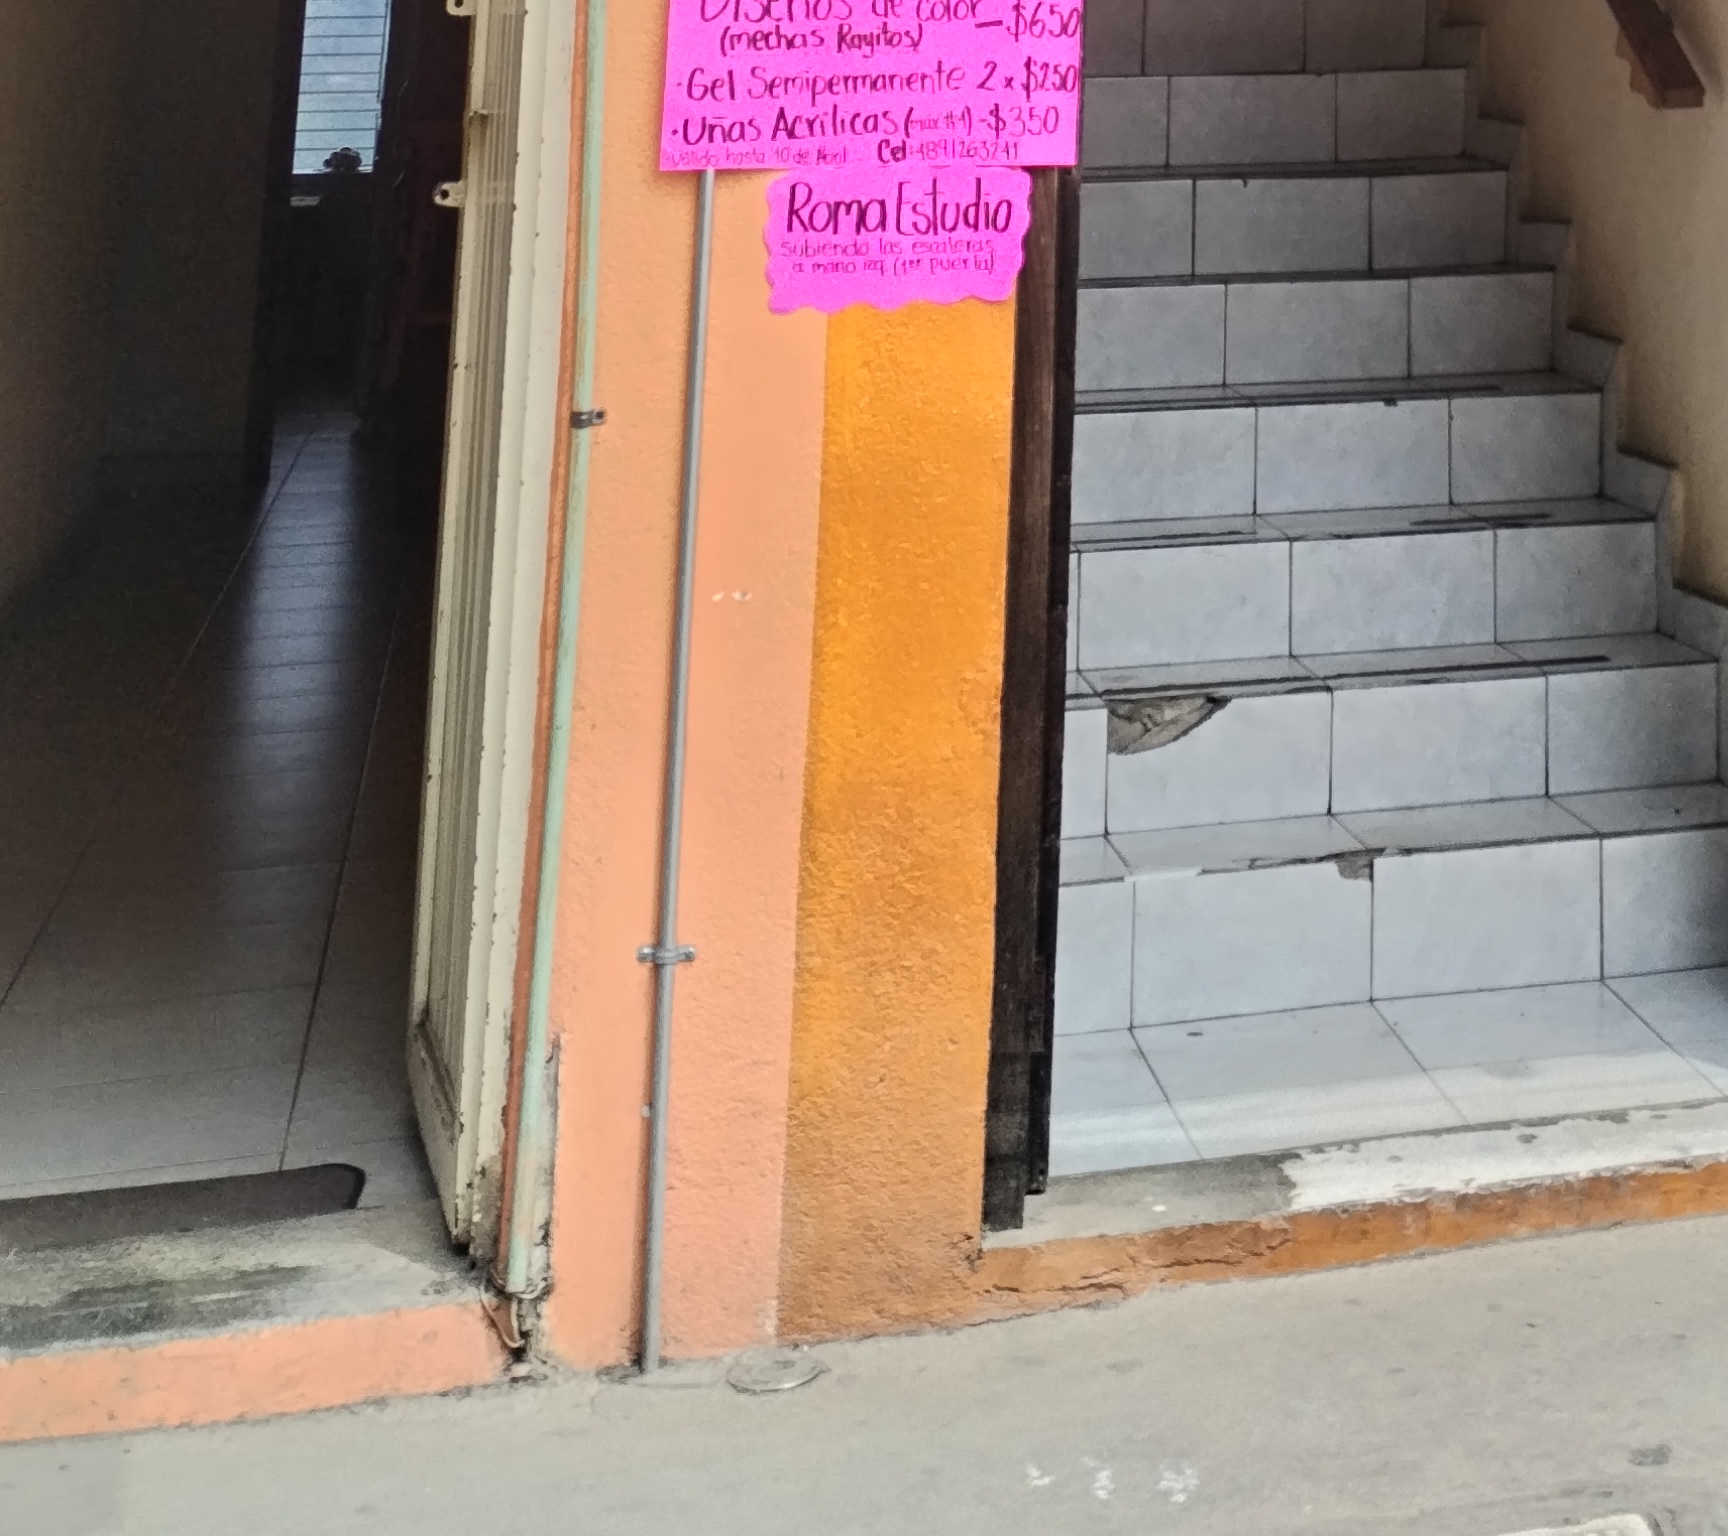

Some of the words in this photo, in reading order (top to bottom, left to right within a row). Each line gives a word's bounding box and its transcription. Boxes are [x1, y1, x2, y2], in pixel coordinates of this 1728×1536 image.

[686, 67, 736, 101] Gel
[748, 60, 966, 108] Semipermanente
[976, 60, 998, 92] 2
[1004, 76, 1015, 91] x
[682, 116, 761, 146] Uñas
[787, 181, 887, 235] Roma
[896, 177, 1012, 236] Estudio
